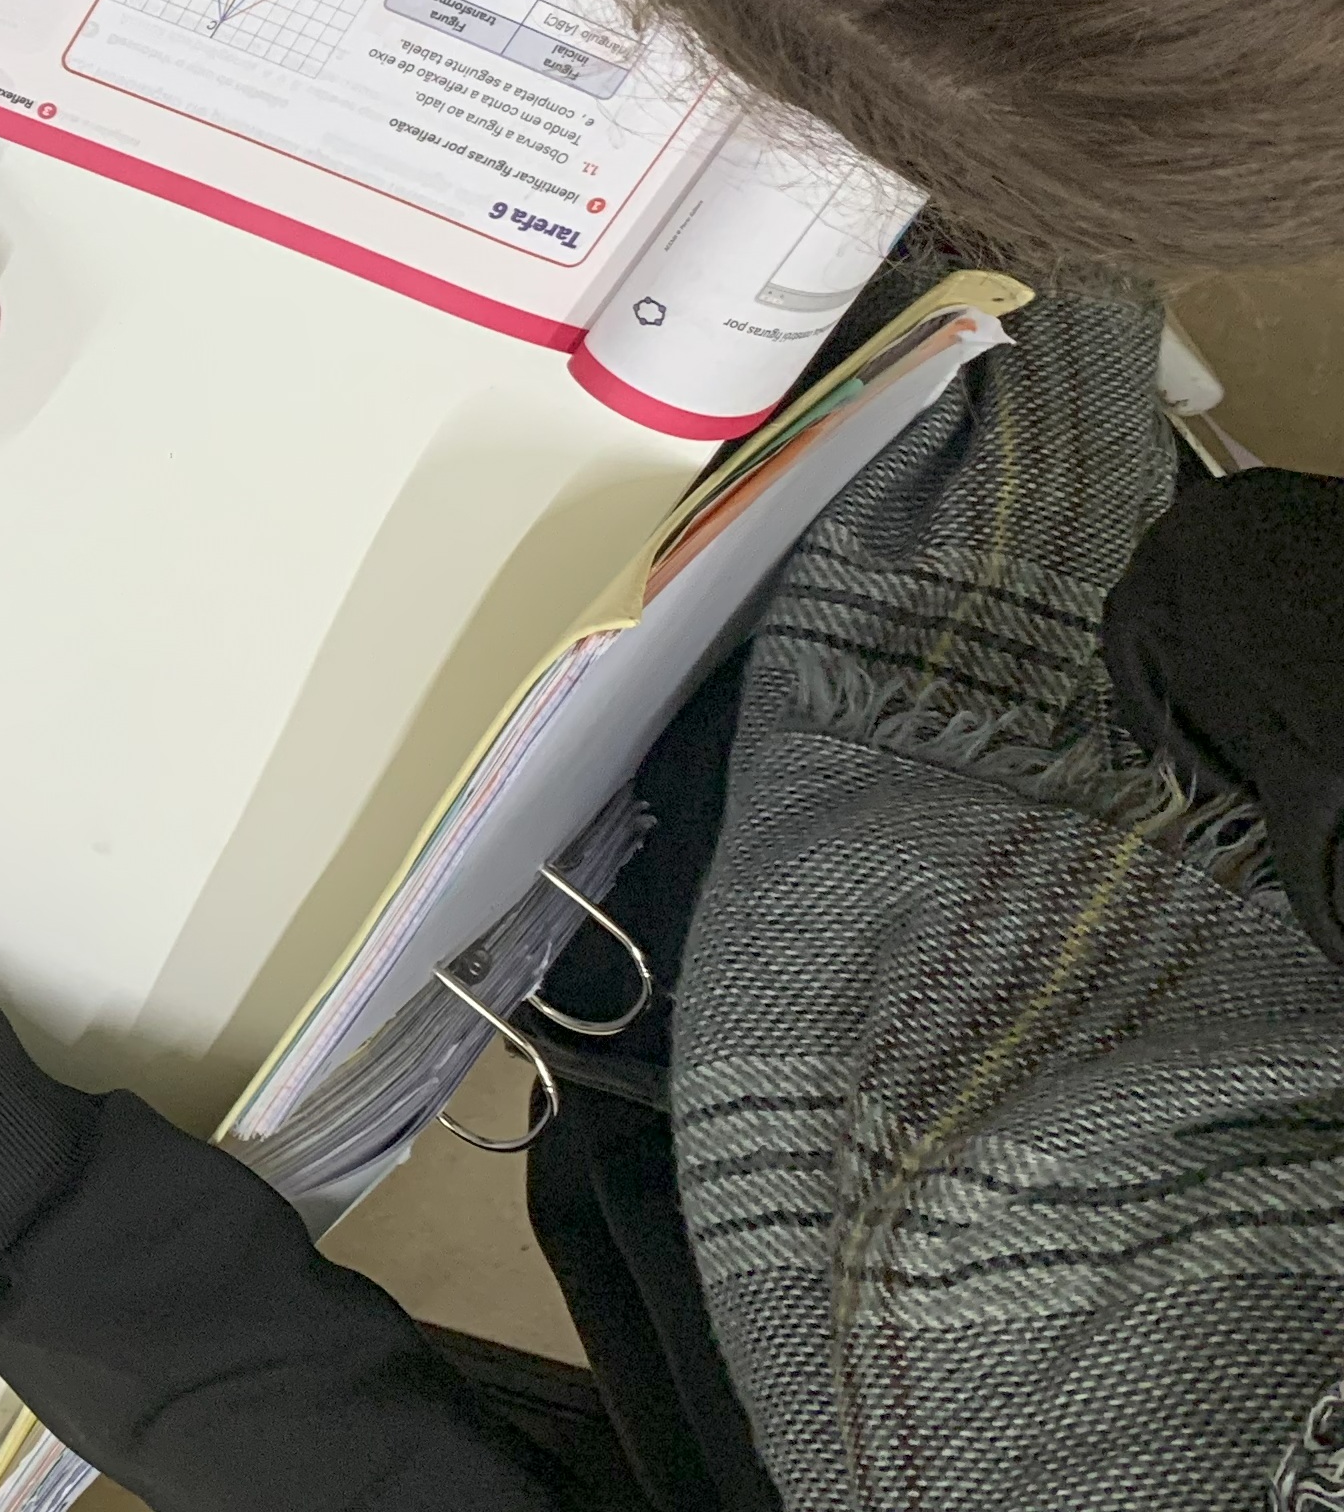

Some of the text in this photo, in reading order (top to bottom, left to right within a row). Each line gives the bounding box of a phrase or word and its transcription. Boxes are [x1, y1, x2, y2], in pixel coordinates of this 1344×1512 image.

[429, 9, 466, 32] Figura
[400, 38, 443, 65] tabela.
[550, 44, 589, 67] inicial
[443, 58, 502, 87] seguinte
[542, 57, 579, 80] Figura
[368, 48, 581, 146] Tendo em conta a reflexão de eixo
[502, 82, 512, 92] a
[513, 86, 575, 118] completa
[415, 90, 569, 164] Observa a figura ao lado.
[388, 118, 580, 204] Identificar figuras por reflexão
[581, 161, 598, 176] 1.1.
[488, 201, 580, 249] Tarefa 6
[721, 316, 748, 335] por
